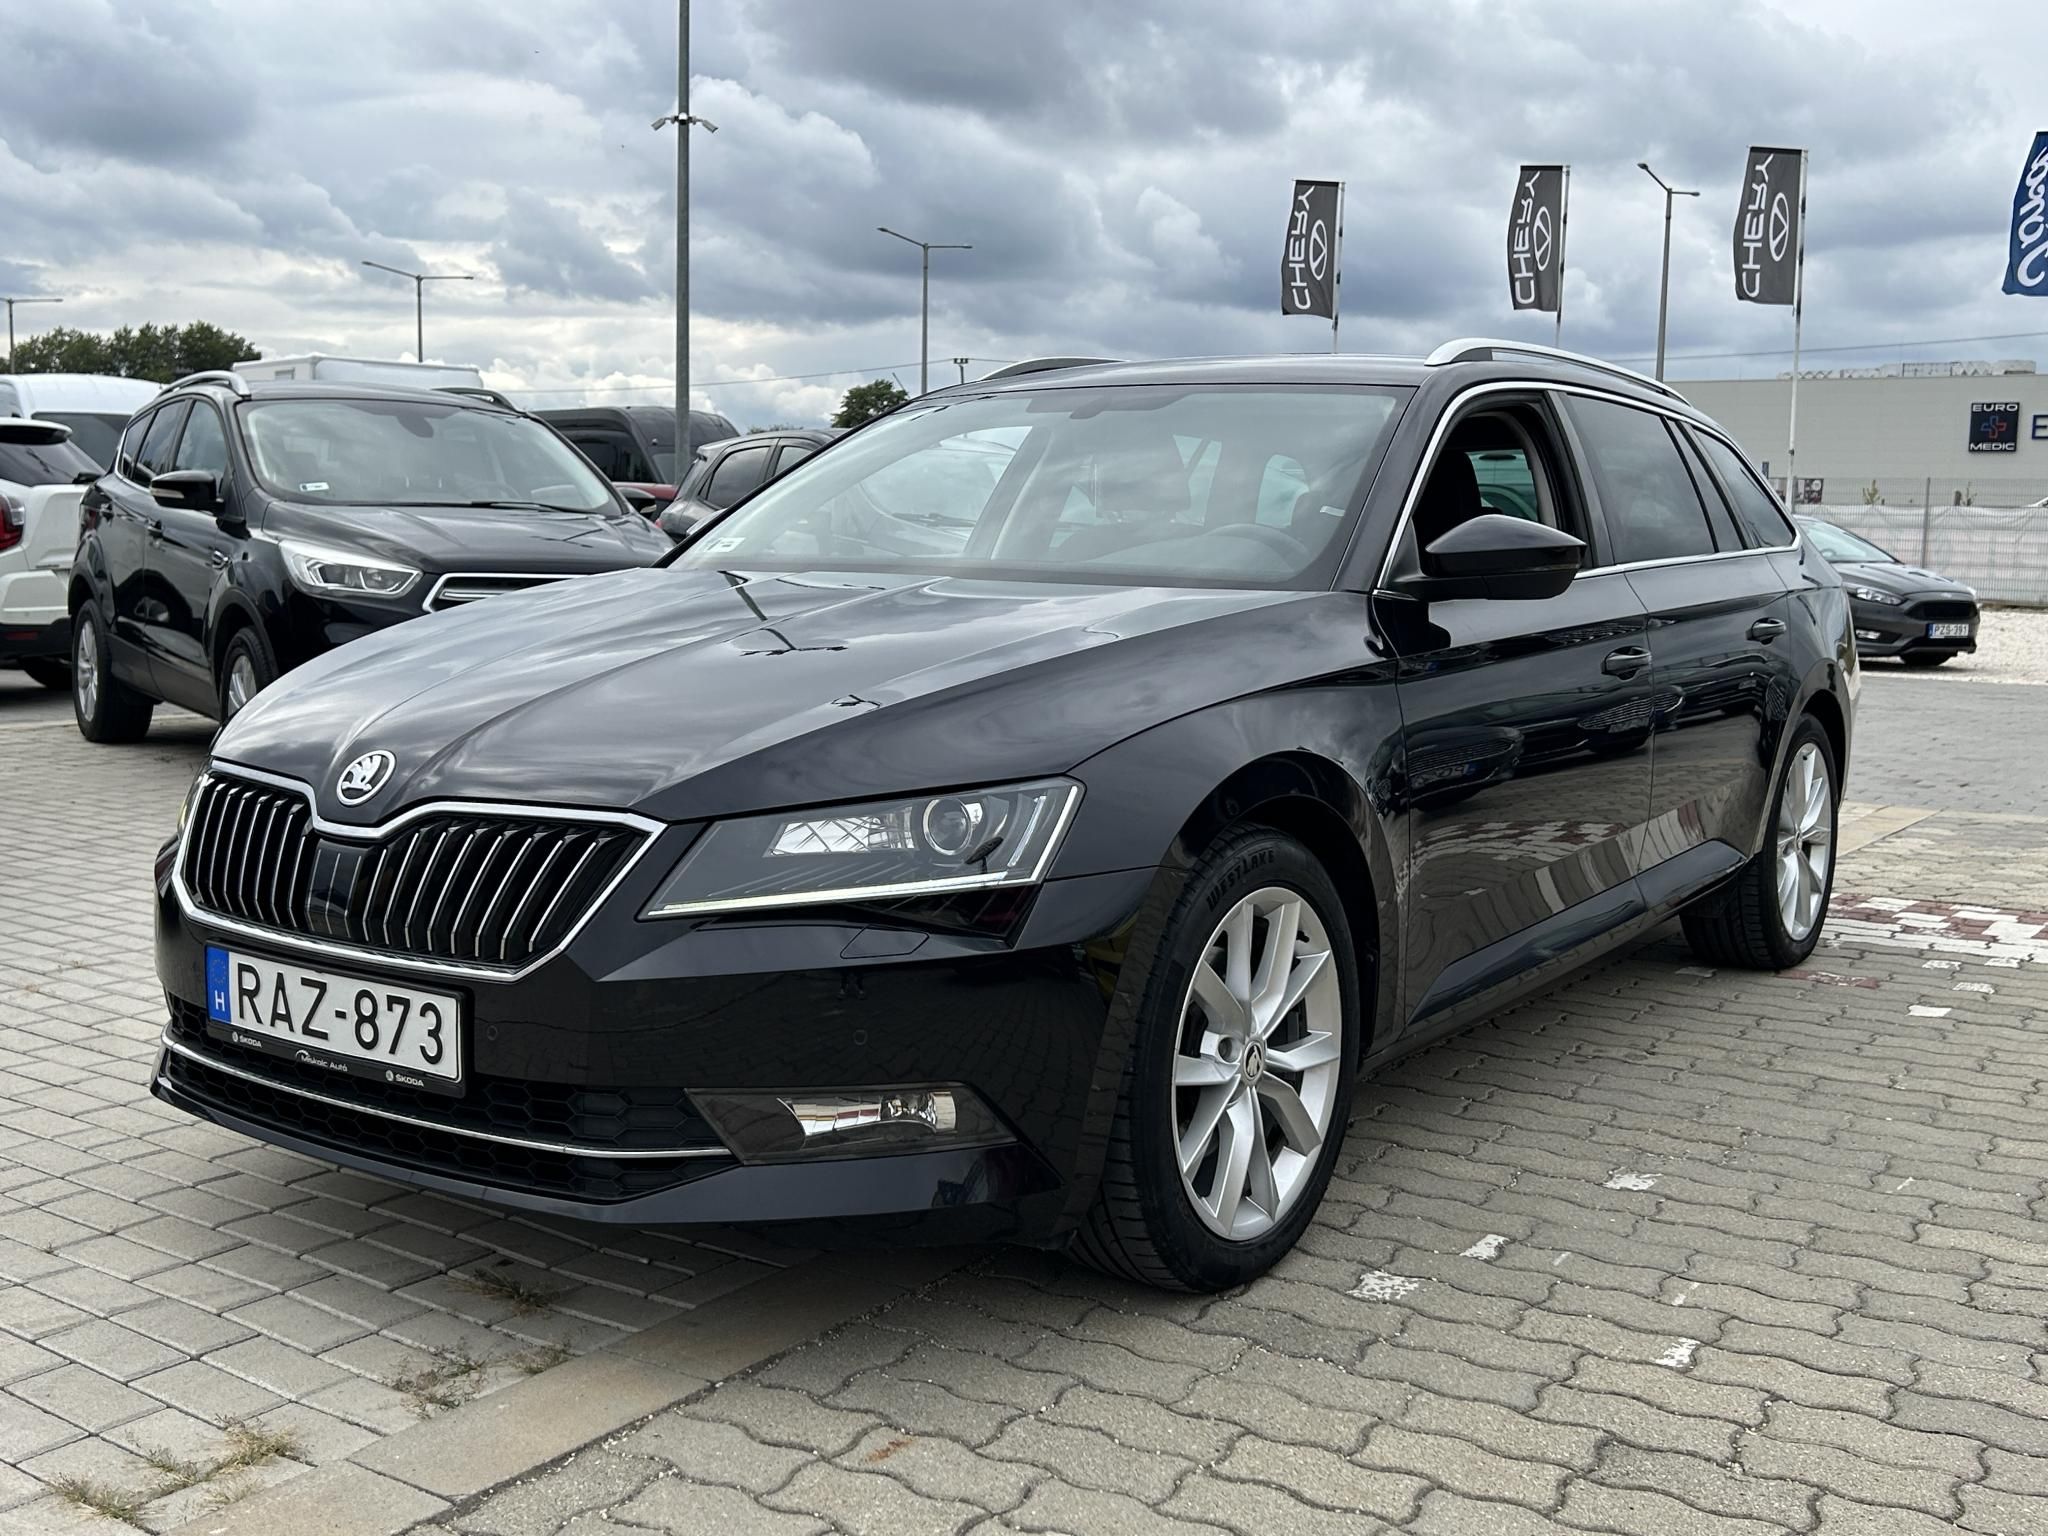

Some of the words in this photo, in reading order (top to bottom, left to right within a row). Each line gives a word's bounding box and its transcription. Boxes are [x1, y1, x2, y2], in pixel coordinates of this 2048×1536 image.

[1972, 403, 2018, 412] EURO
[1969, 442, 2015, 451] MEDIC
[1206, 850, 1275, 912] WESTLAKE
[214, 990, 225, 1012] H
[237, 962, 443, 1065] RAZ-873
